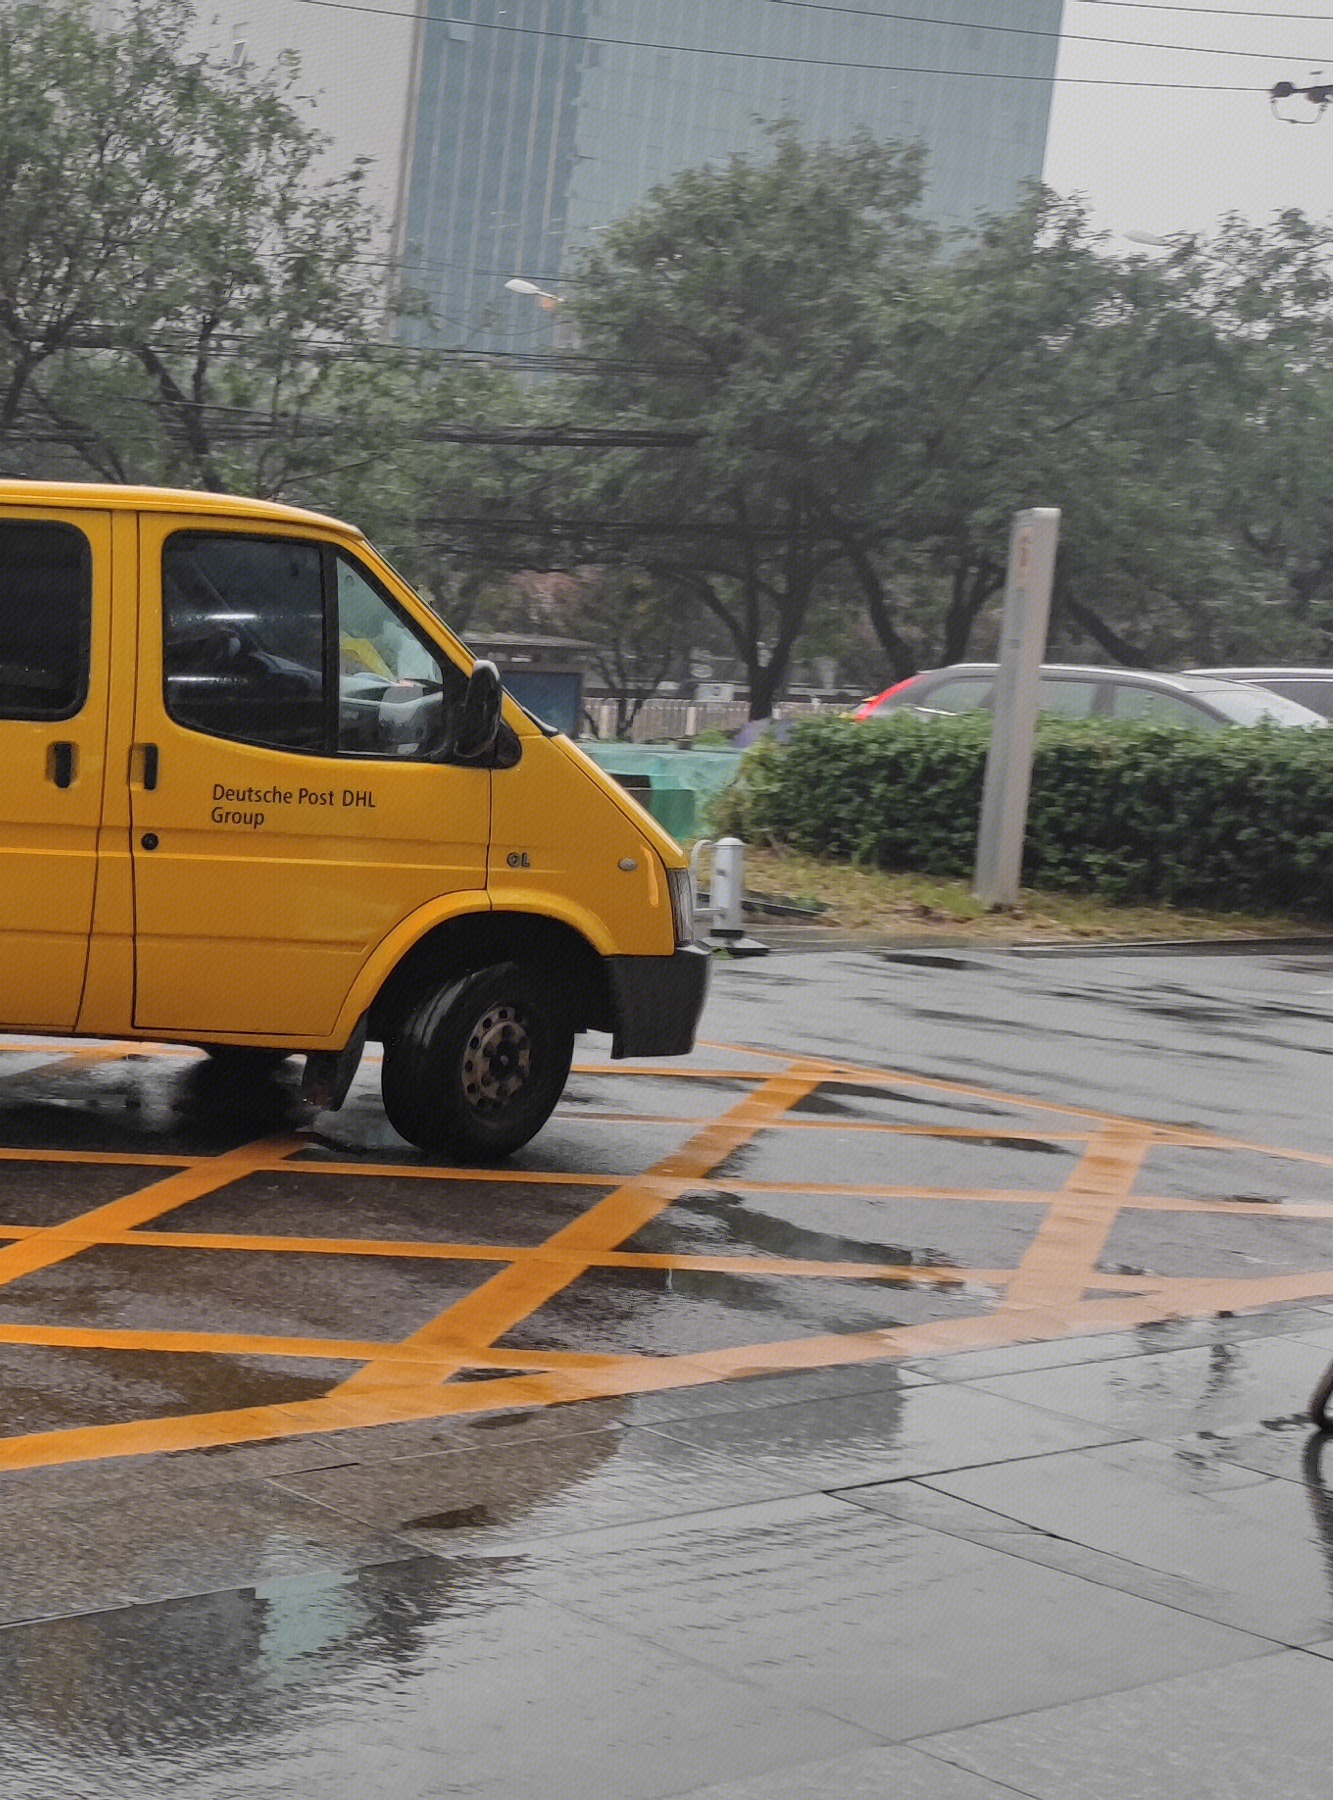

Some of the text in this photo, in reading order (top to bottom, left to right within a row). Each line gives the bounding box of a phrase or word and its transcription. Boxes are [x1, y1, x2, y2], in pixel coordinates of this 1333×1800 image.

[212, 783, 376, 808] Deutsche Post DHL
[211, 806, 265, 829] Group
